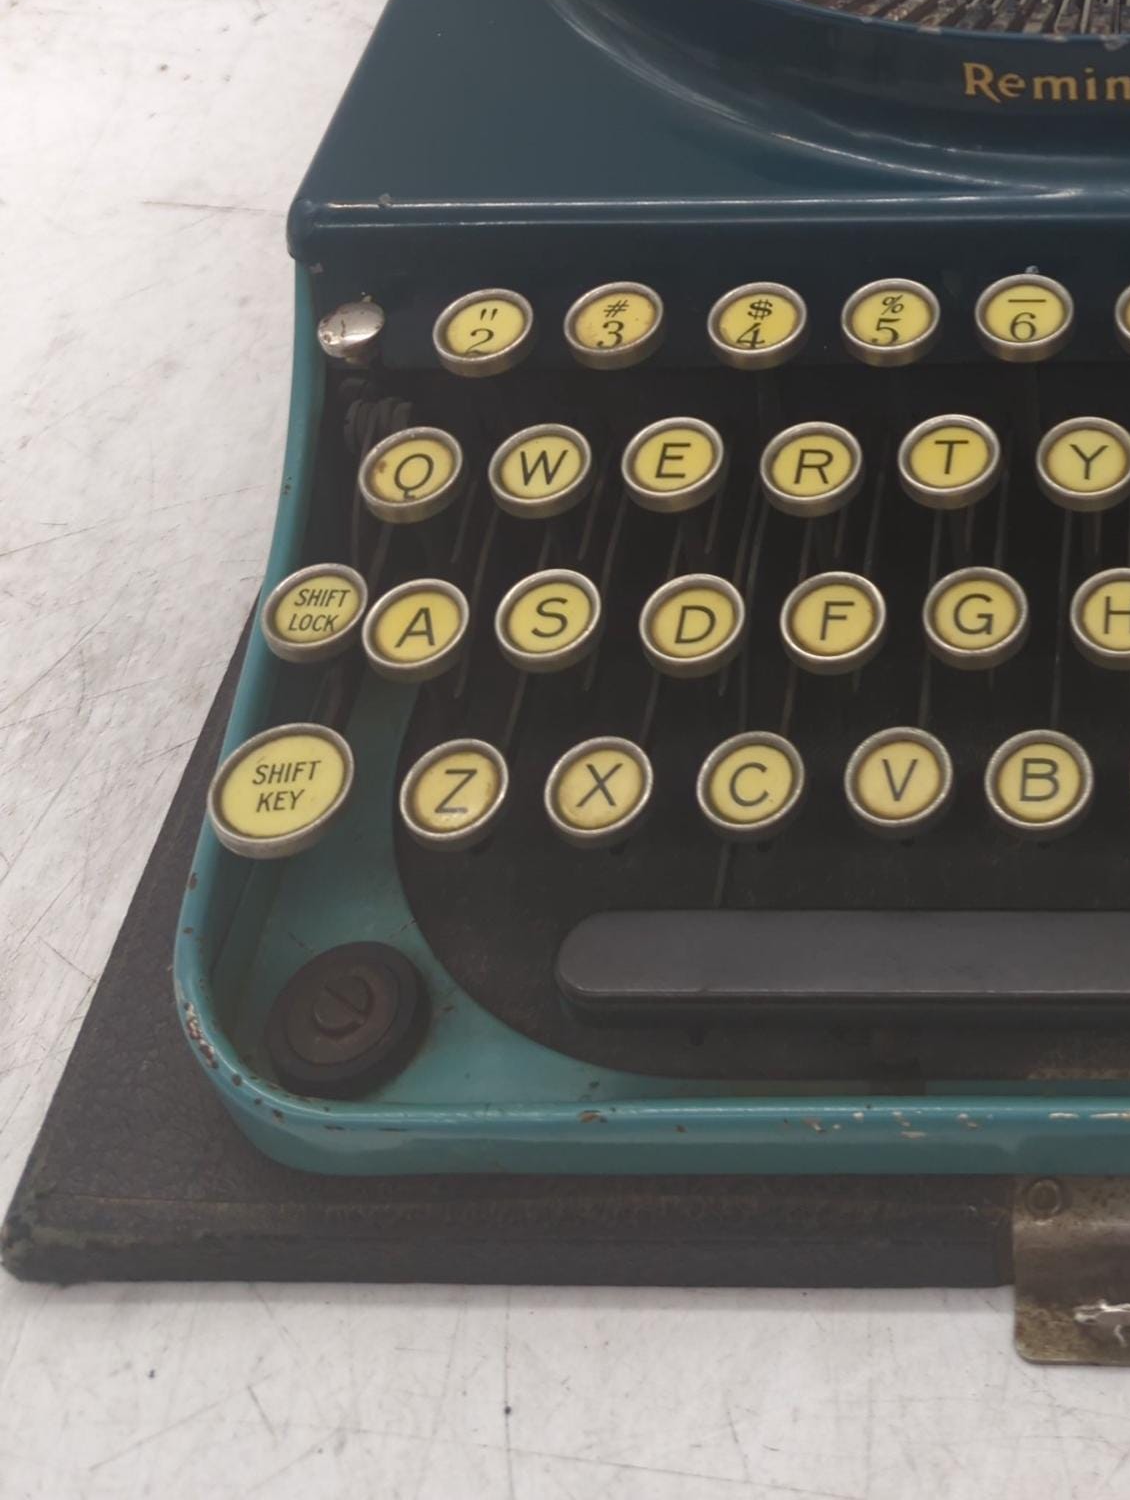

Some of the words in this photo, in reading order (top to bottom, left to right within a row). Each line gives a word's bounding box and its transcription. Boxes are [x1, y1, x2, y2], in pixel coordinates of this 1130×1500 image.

[603, 300, 628, 318] #
[748, 299, 772, 321] $
[882, 296, 904, 314] %
[466, 328, 495, 355] 2
[597, 320, 624, 348] 3
[737, 322, 763, 350] 4
[871, 318, 900, 345] 5
[1009, 312, 1037, 342] 6
[520, 449, 569, 486] W
[655, 442, 691, 479] E
[793, 448, 834, 485] R
[934, 439, 969, 475] T
[1069, 443, 1109, 480] Y
[394, 453, 434, 499] Q
[294, 588, 351, 608] SHIFT
[953, 593, 994, 635] G
[288, 612, 339, 632] LOCK
[395, 607, 436, 648] A
[532, 597, 569, 638] S
[674, 605, 717, 644] D
[820, 601, 855, 641] F
[252, 760, 322, 786] SHIFT
[434, 769, 478, 814] Z
[576, 763, 623, 808] X
[729, 762, 769, 807] C
[882, 758, 918, 802] V
[1019, 757, 1060, 802] B
[256, 790, 305, 813] KEY
